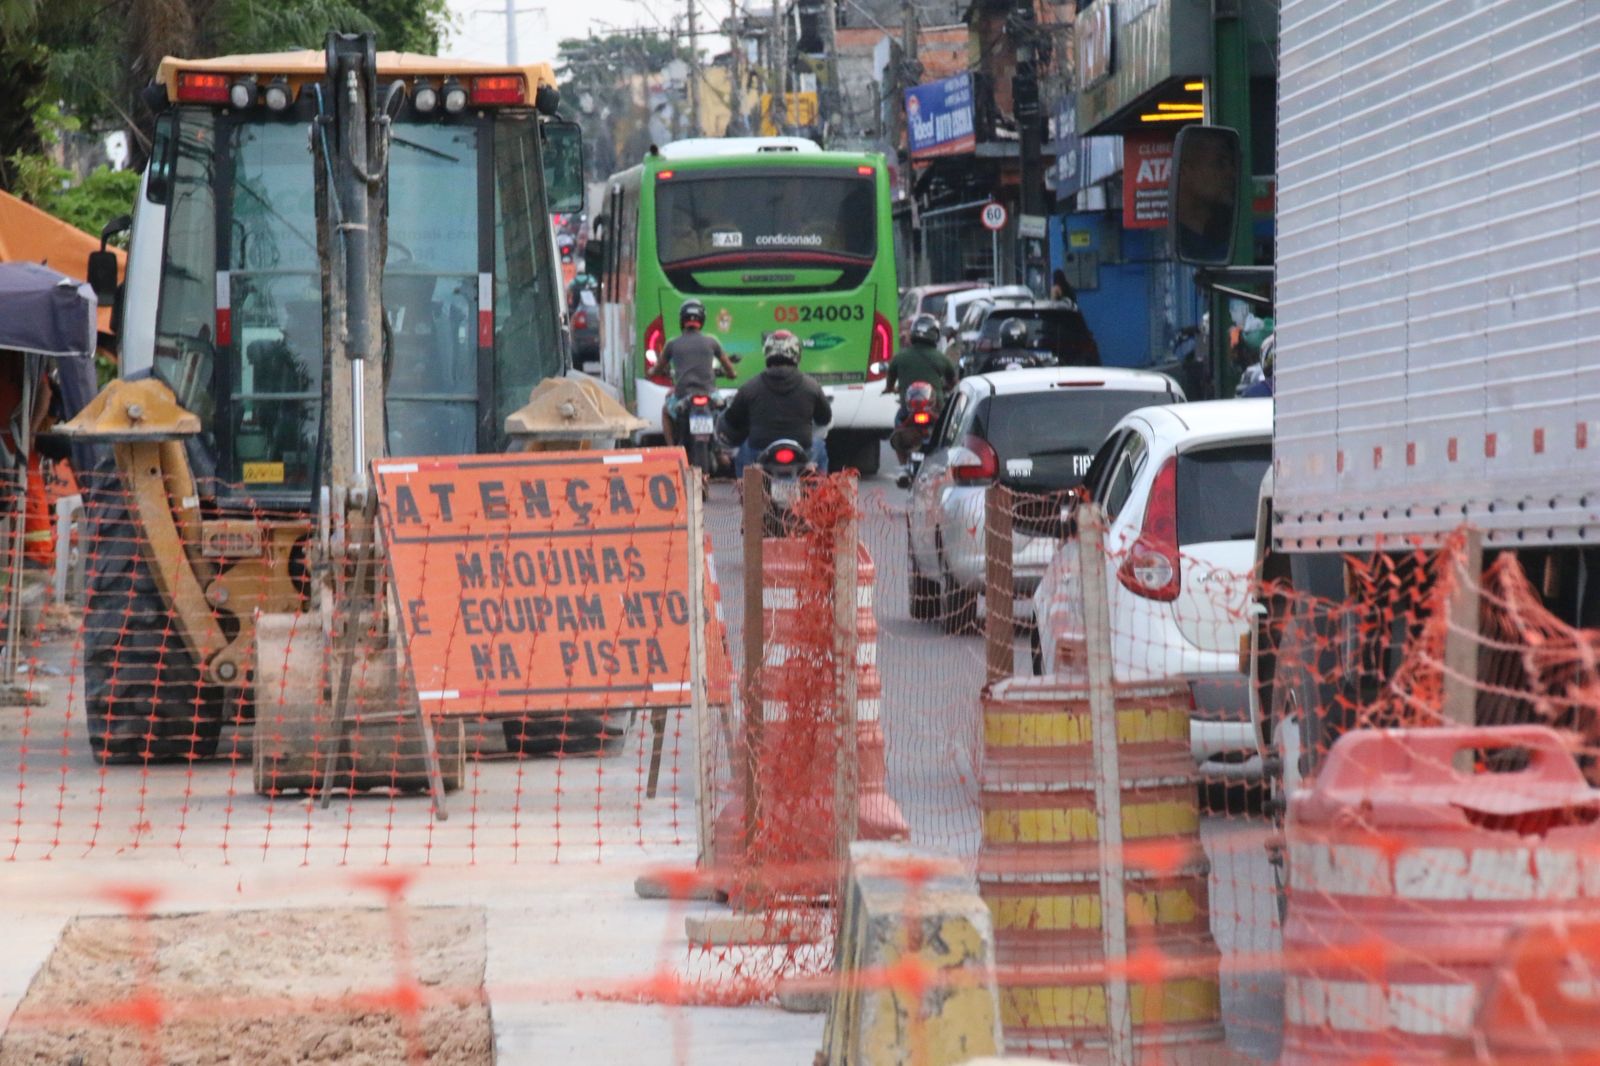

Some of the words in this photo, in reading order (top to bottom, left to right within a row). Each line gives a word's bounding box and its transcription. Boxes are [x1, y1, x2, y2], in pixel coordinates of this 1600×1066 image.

[986, 207, 1001, 220] 60
[756, 233, 822, 246] condicionado
[774, 305, 865, 323] 0524003
[395, 467, 678, 526] ATENÇÃO
[455, 545, 646, 589] MÁQUINAS
[407, 600, 432, 635] E
[471, 643, 521, 680] NA
[560, 638, 669, 677] PISTA
